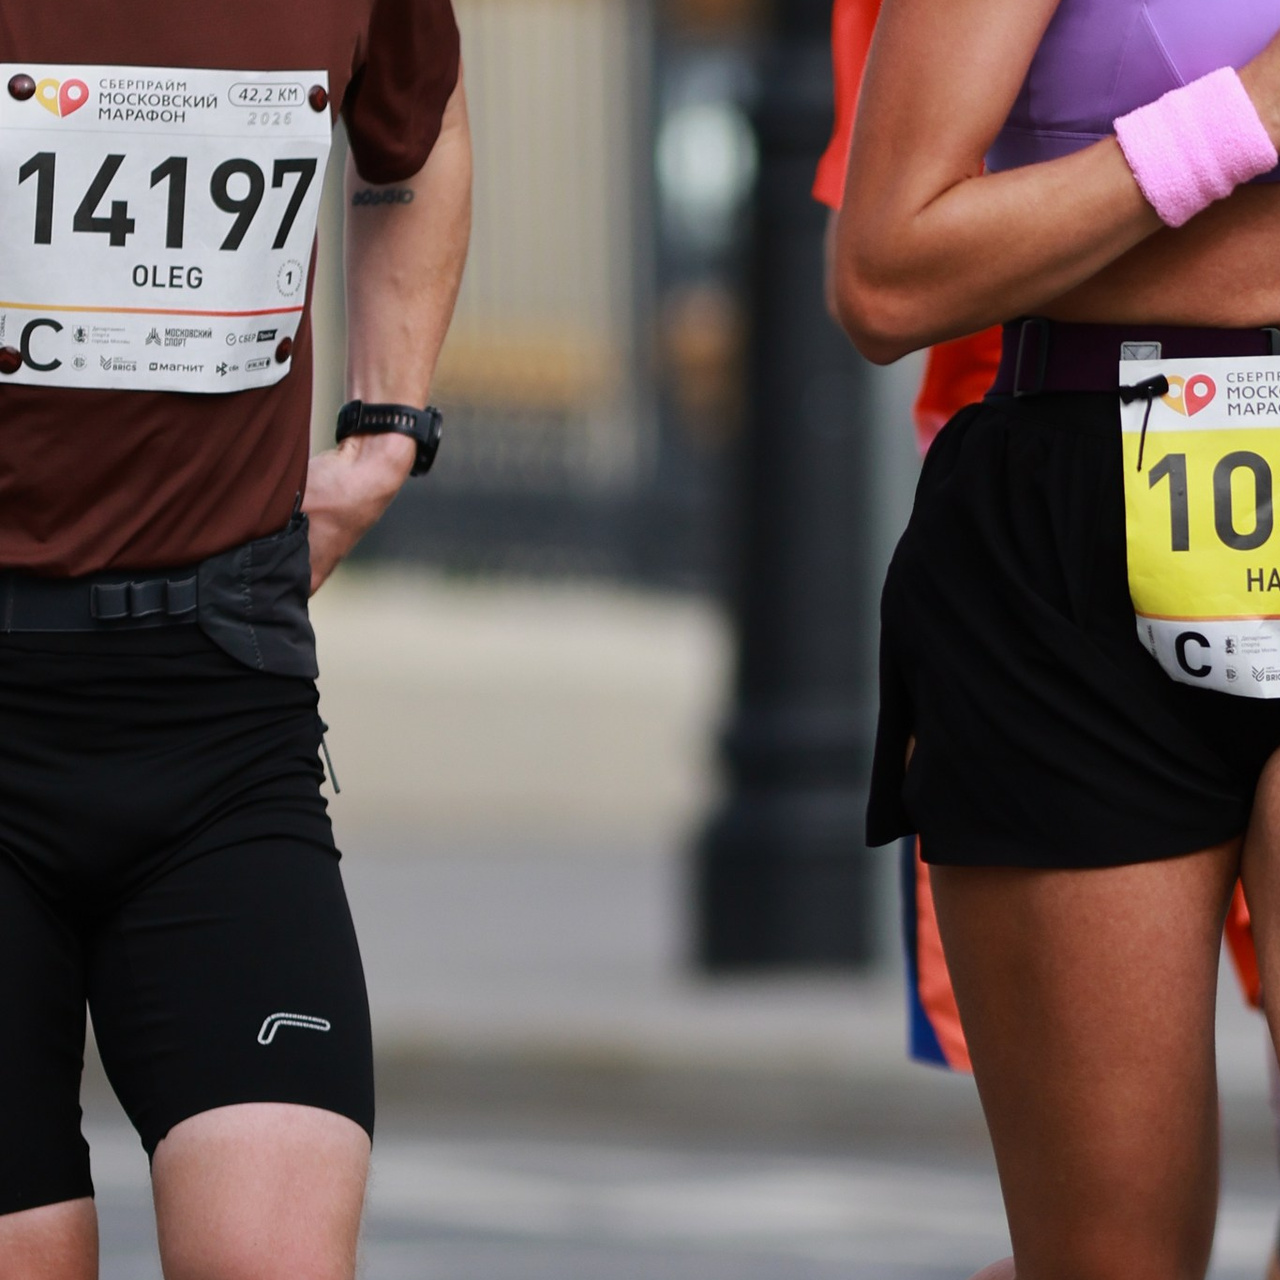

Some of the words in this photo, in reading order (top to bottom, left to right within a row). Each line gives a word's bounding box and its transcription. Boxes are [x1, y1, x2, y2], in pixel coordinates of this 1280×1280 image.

[99, 78, 187, 92] СБЕРПРАЙМ
[99, 92, 218, 109] МОСКОВСКИЙ
[238, 88, 273, 103] 42,2
[278, 88, 298, 102] КМ
[98, 107, 186, 123] МАРАФОН
[18, 151, 318, 251] 14197
[132, 264, 203, 289] OLEG
[286, 271, 293, 285] 1
